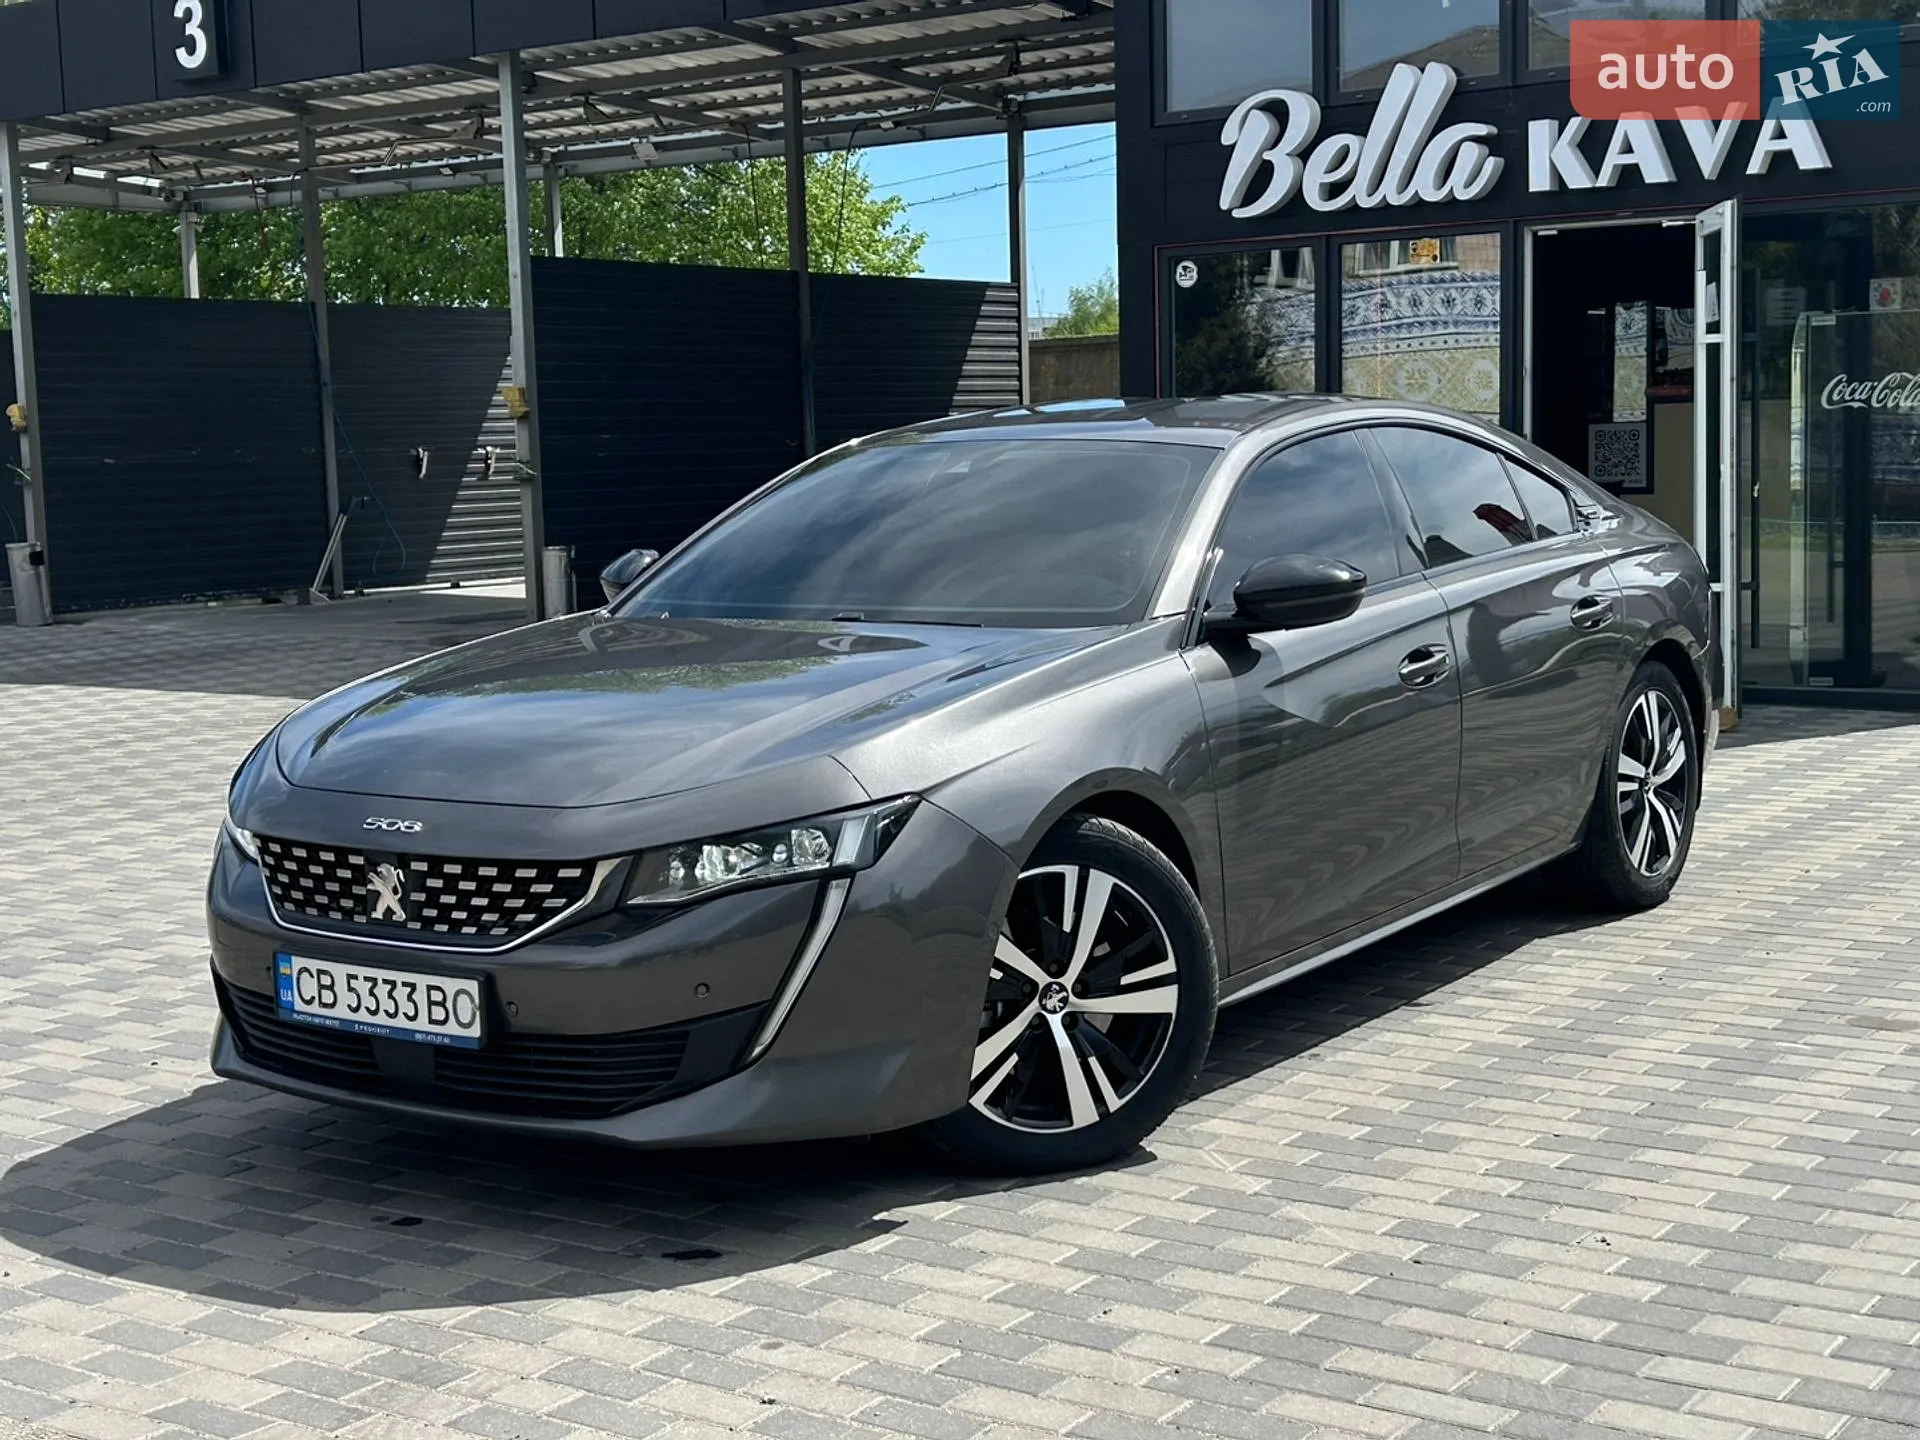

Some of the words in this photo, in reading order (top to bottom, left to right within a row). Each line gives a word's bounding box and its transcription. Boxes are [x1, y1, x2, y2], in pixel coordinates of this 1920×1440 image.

[174, 0, 207, 69] 3
[1219, 61, 1505, 218] Bella
[1527, 96, 1833, 193] KAVA
[280, 988, 293, 1001] UA
